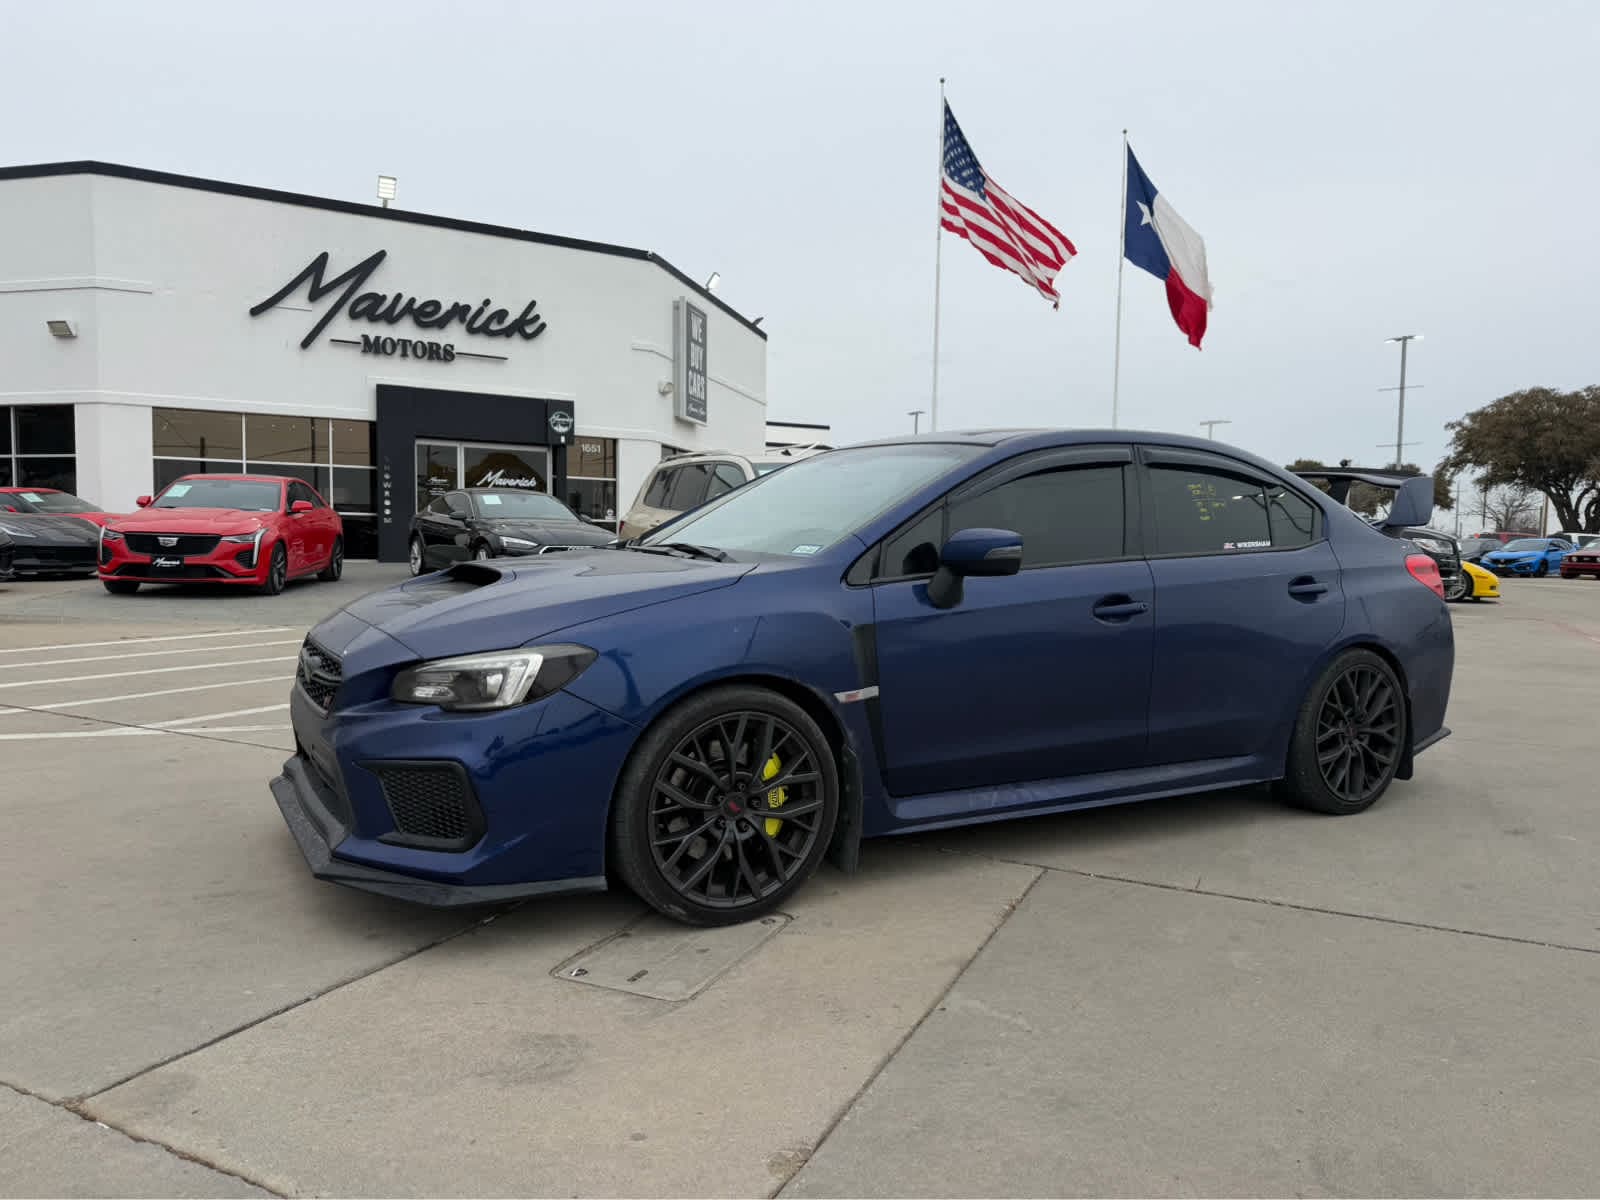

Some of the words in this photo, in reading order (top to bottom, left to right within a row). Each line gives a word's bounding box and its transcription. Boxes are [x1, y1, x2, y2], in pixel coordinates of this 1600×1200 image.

[249, 249, 547, 349] Maverick
[690, 312, 703, 342] WE
[361, 334, 455, 362] MOTORS
[690, 341, 704, 371] BUY
[688, 370, 705, 401] CARS
[383, 455, 392, 524] HOWROOM
[476, 468, 537, 488] Maverick
